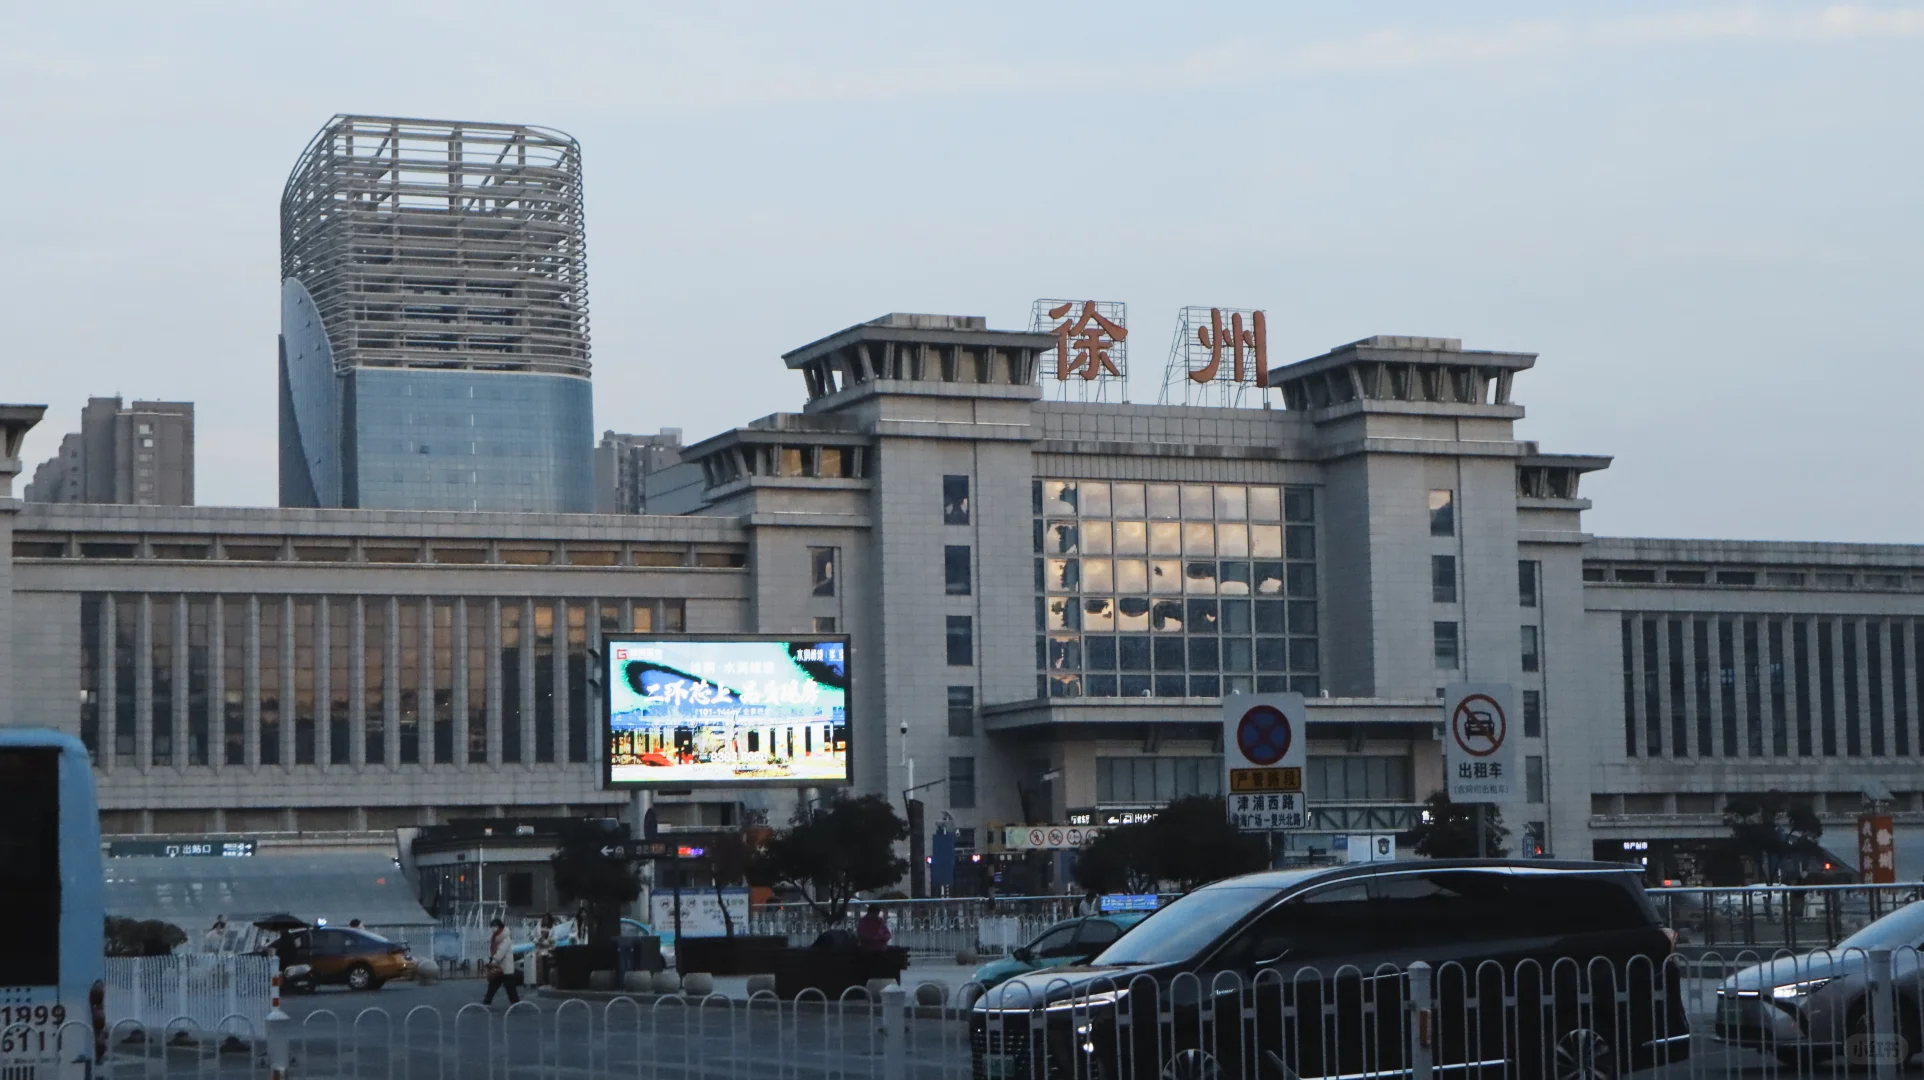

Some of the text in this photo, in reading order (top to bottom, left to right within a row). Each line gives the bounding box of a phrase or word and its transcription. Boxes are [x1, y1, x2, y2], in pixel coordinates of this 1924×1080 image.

[1049, 300, 1268, 388] 徐州
[1459, 762, 1502, 779] 出租车
[1237, 795, 1294, 811] 津浦西路
[182, 843, 211, 854] 出站口
